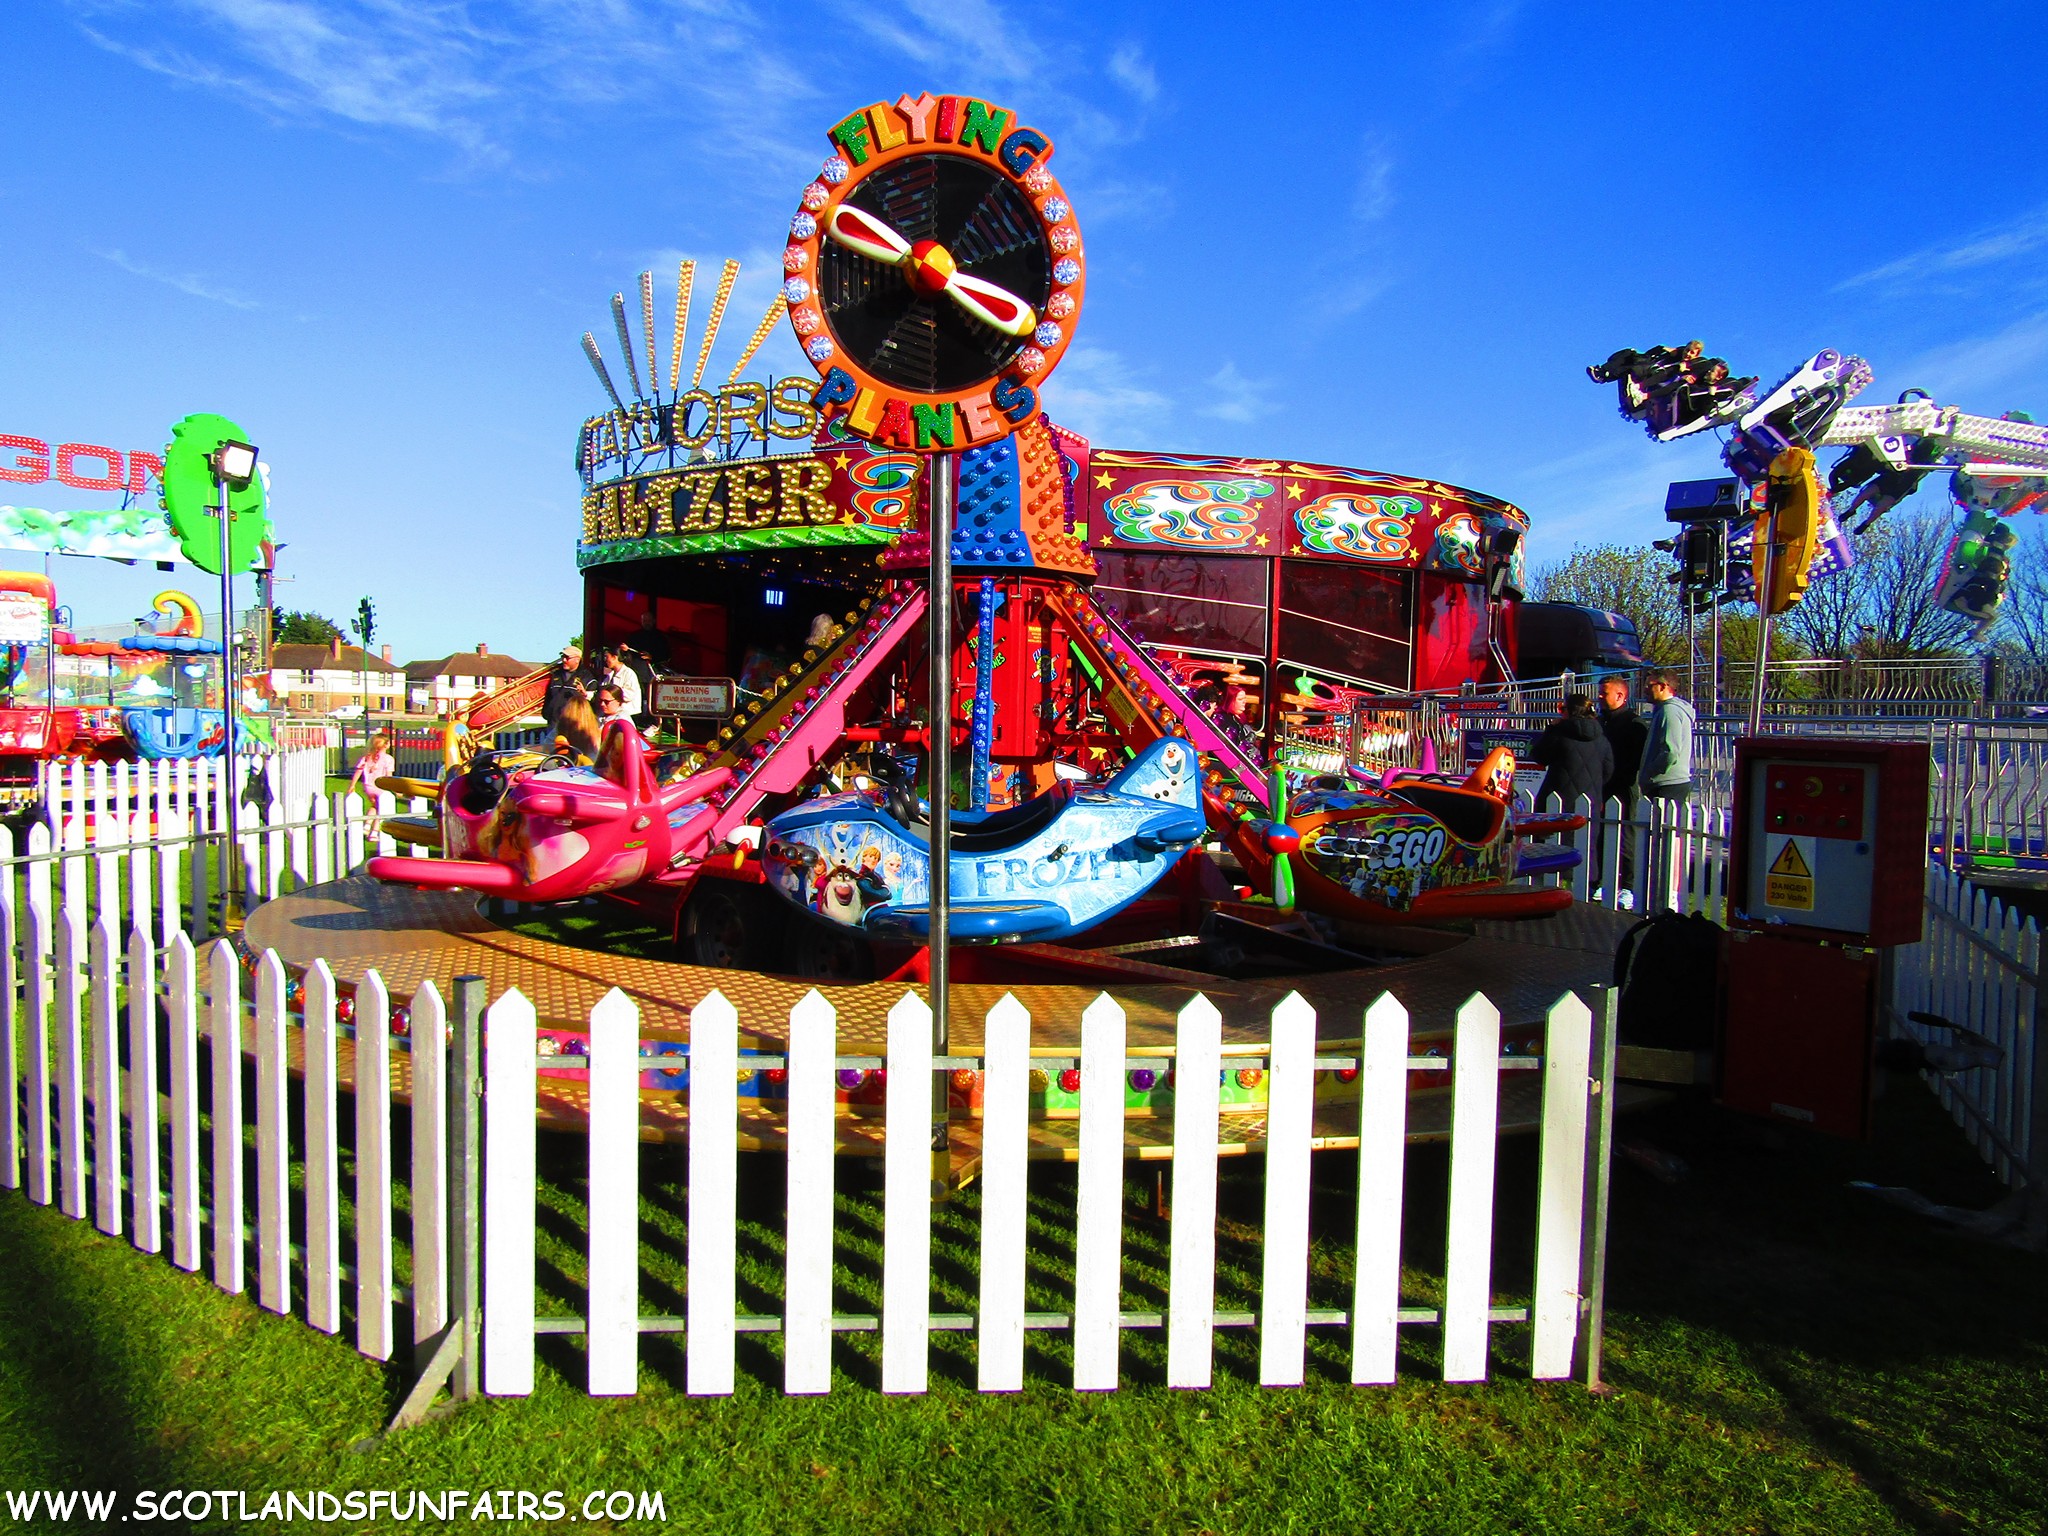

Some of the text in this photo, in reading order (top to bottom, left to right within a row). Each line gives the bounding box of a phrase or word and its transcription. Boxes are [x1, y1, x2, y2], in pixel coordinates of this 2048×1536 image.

[832, 91, 1048, 176] FLYING
[809, 366, 1036, 447] PLANES
[586, 376, 818, 470] TAYLORS
[581, 459, 837, 544] WALTZER
[673, 686, 710, 695] WARNING
[1445, 701, 1499, 710] NO ENTRY
[1488, 740, 1526, 748] TECHNO
[1487, 749, 1526, 758] PER
[1771, 882, 1808, 892] DANGER
[1771, 892, 1808, 902] 230 Volts
